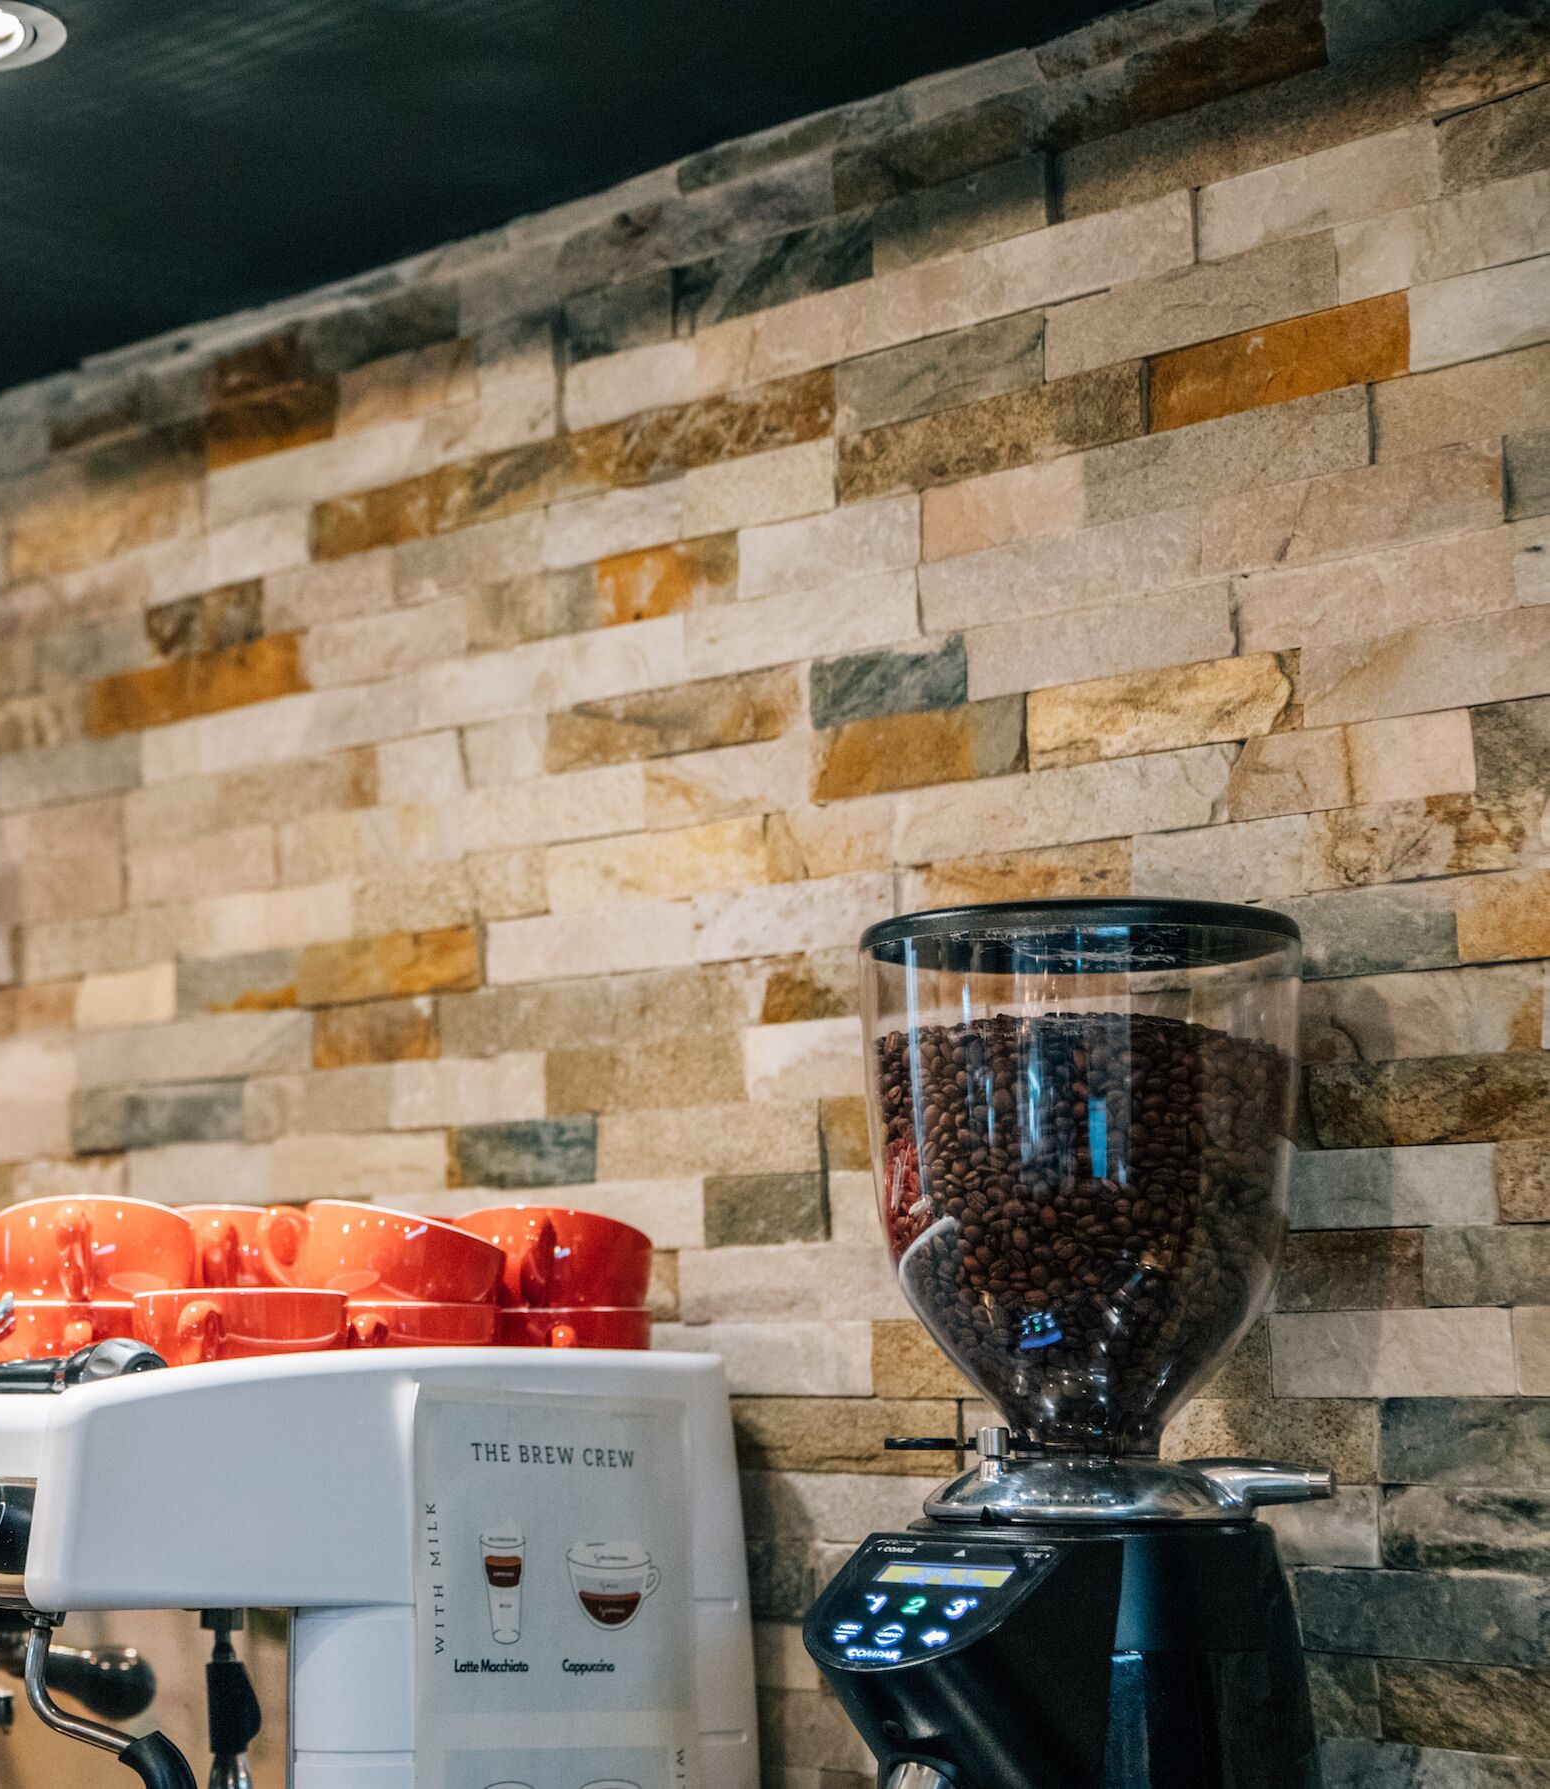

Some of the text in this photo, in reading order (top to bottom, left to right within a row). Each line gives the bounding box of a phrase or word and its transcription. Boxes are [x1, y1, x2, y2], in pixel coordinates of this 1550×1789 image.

[471, 1442, 635, 1468] THE BREW CREW
[883, 1546, 917, 1554] COARSE
[425, 1502, 446, 1655] WITH MILK
[901, 1595, 928, 1616] 2
[454, 1659, 529, 1673] Latte Macchiato
[562, 1659, 615, 1677] Cappuccino
